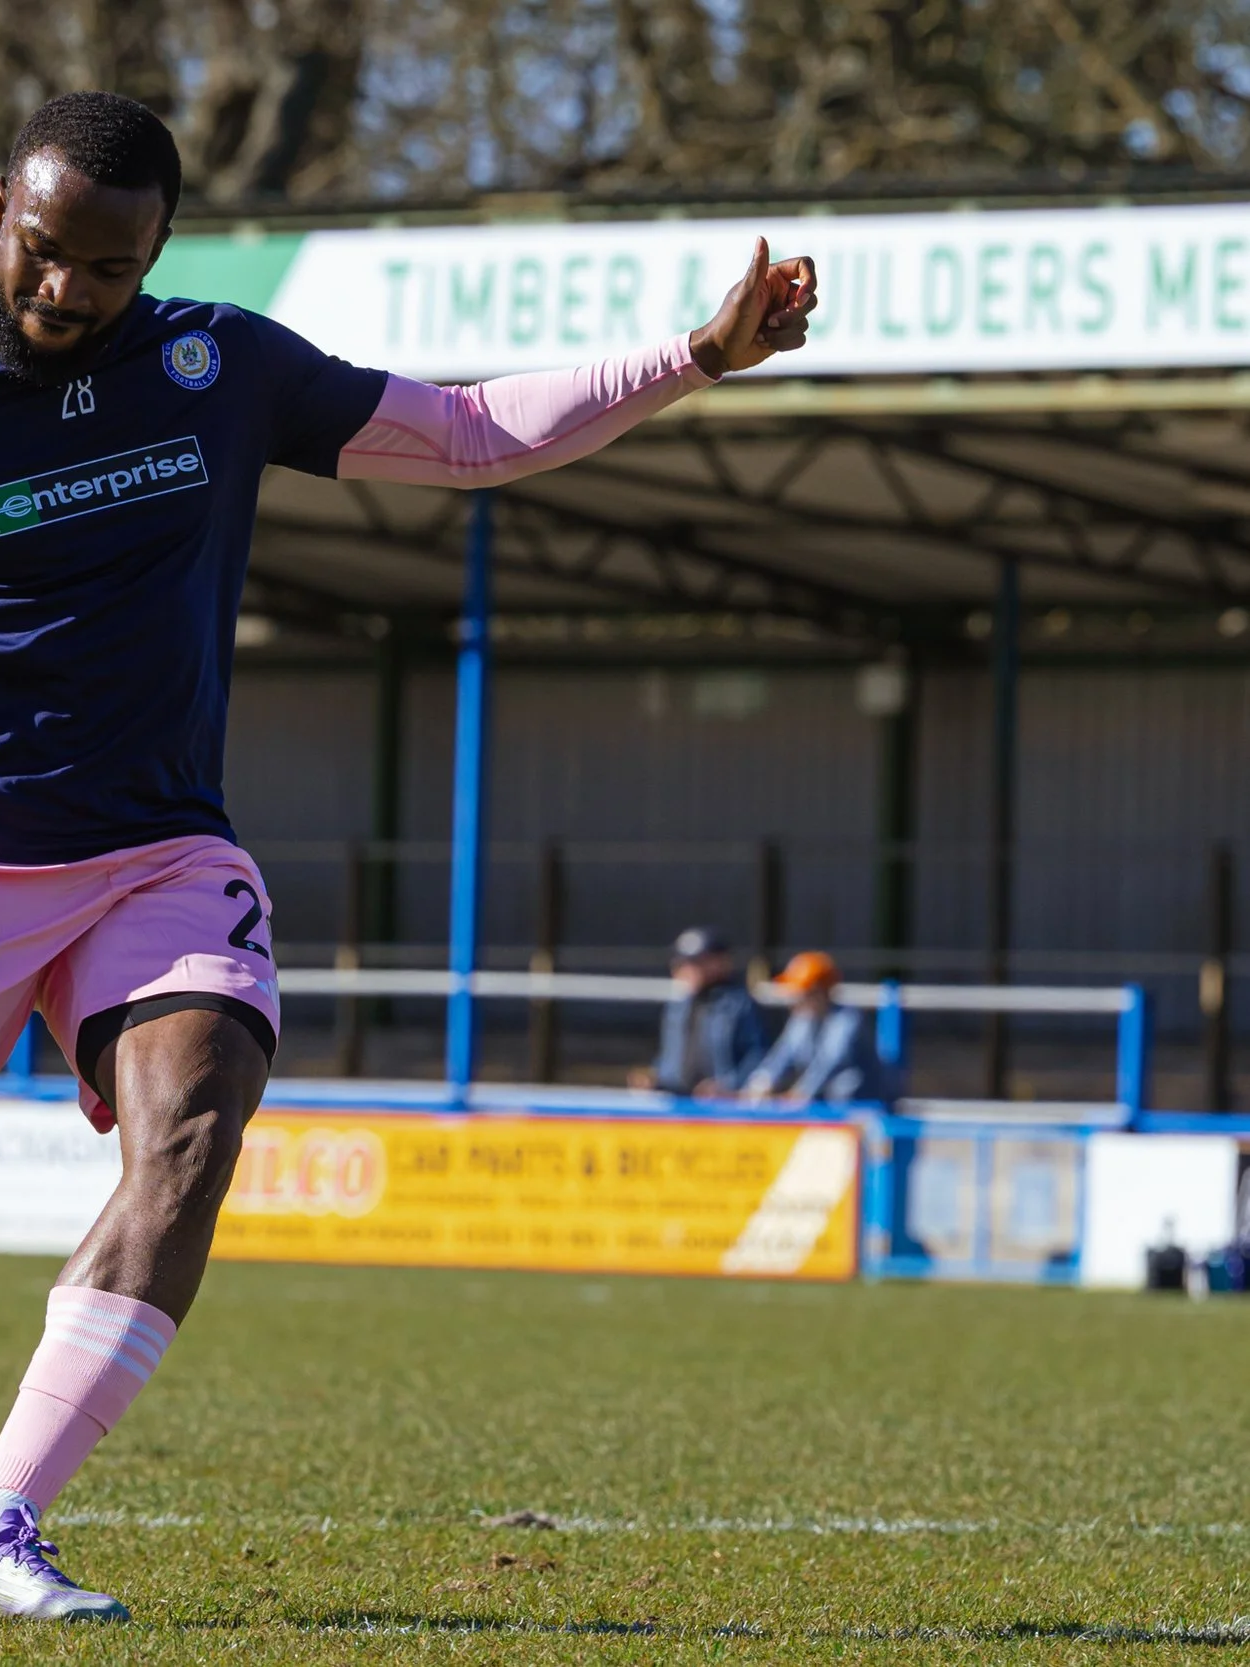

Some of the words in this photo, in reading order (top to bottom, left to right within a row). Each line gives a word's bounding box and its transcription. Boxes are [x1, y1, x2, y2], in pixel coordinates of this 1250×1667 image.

[380, 253, 646, 348] TIMBER
[764, 240, 1117, 338] UILDERS
[62, 375, 95, 419] 28
[170, 369, 207, 387] FOOTBALL
[207, 359, 217, 380] CLUB
[224, 879, 272, 960] 2
